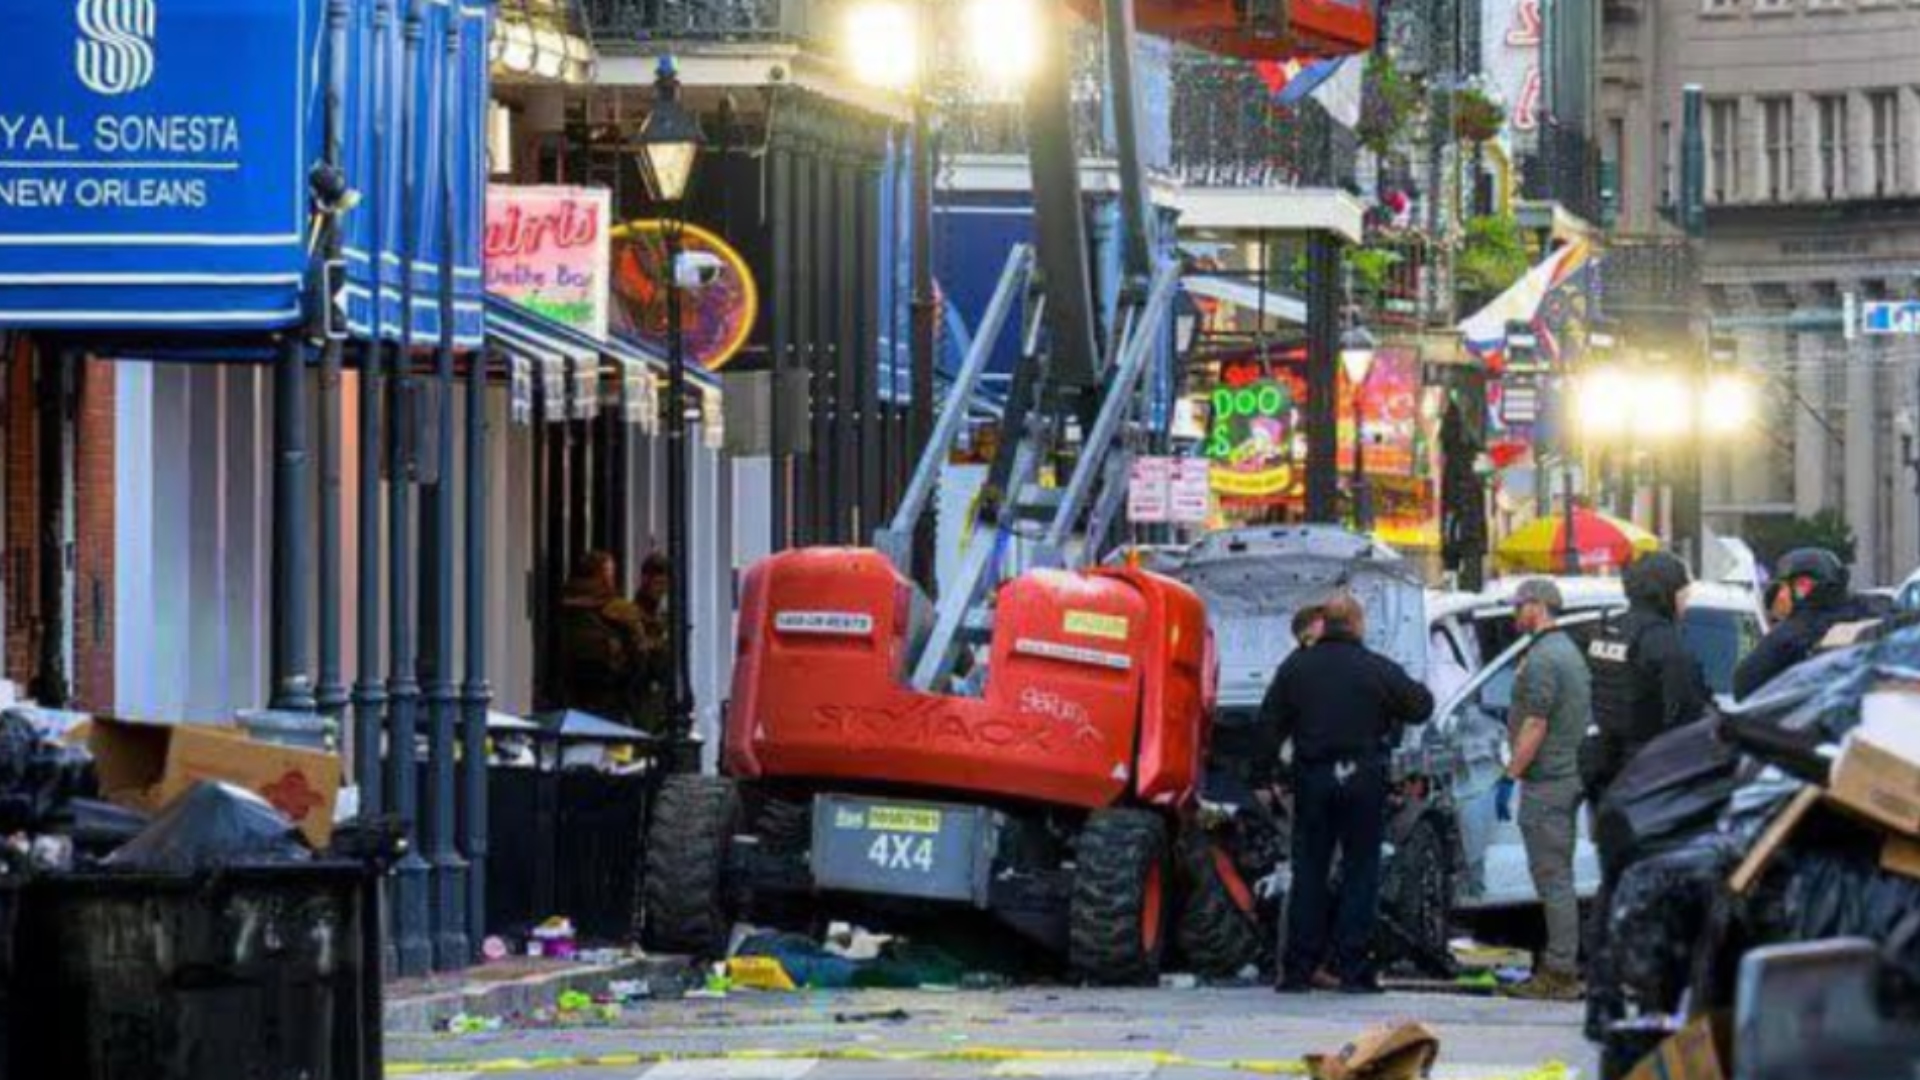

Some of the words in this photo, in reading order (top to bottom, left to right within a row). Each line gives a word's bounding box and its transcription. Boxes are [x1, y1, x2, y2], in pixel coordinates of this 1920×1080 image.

[95, 115, 239, 151] SONESTA
[0, 179, 66, 207] NEW
[75, 178, 206, 207] ORLEANS
[868, 834, 933, 872] 4X4
